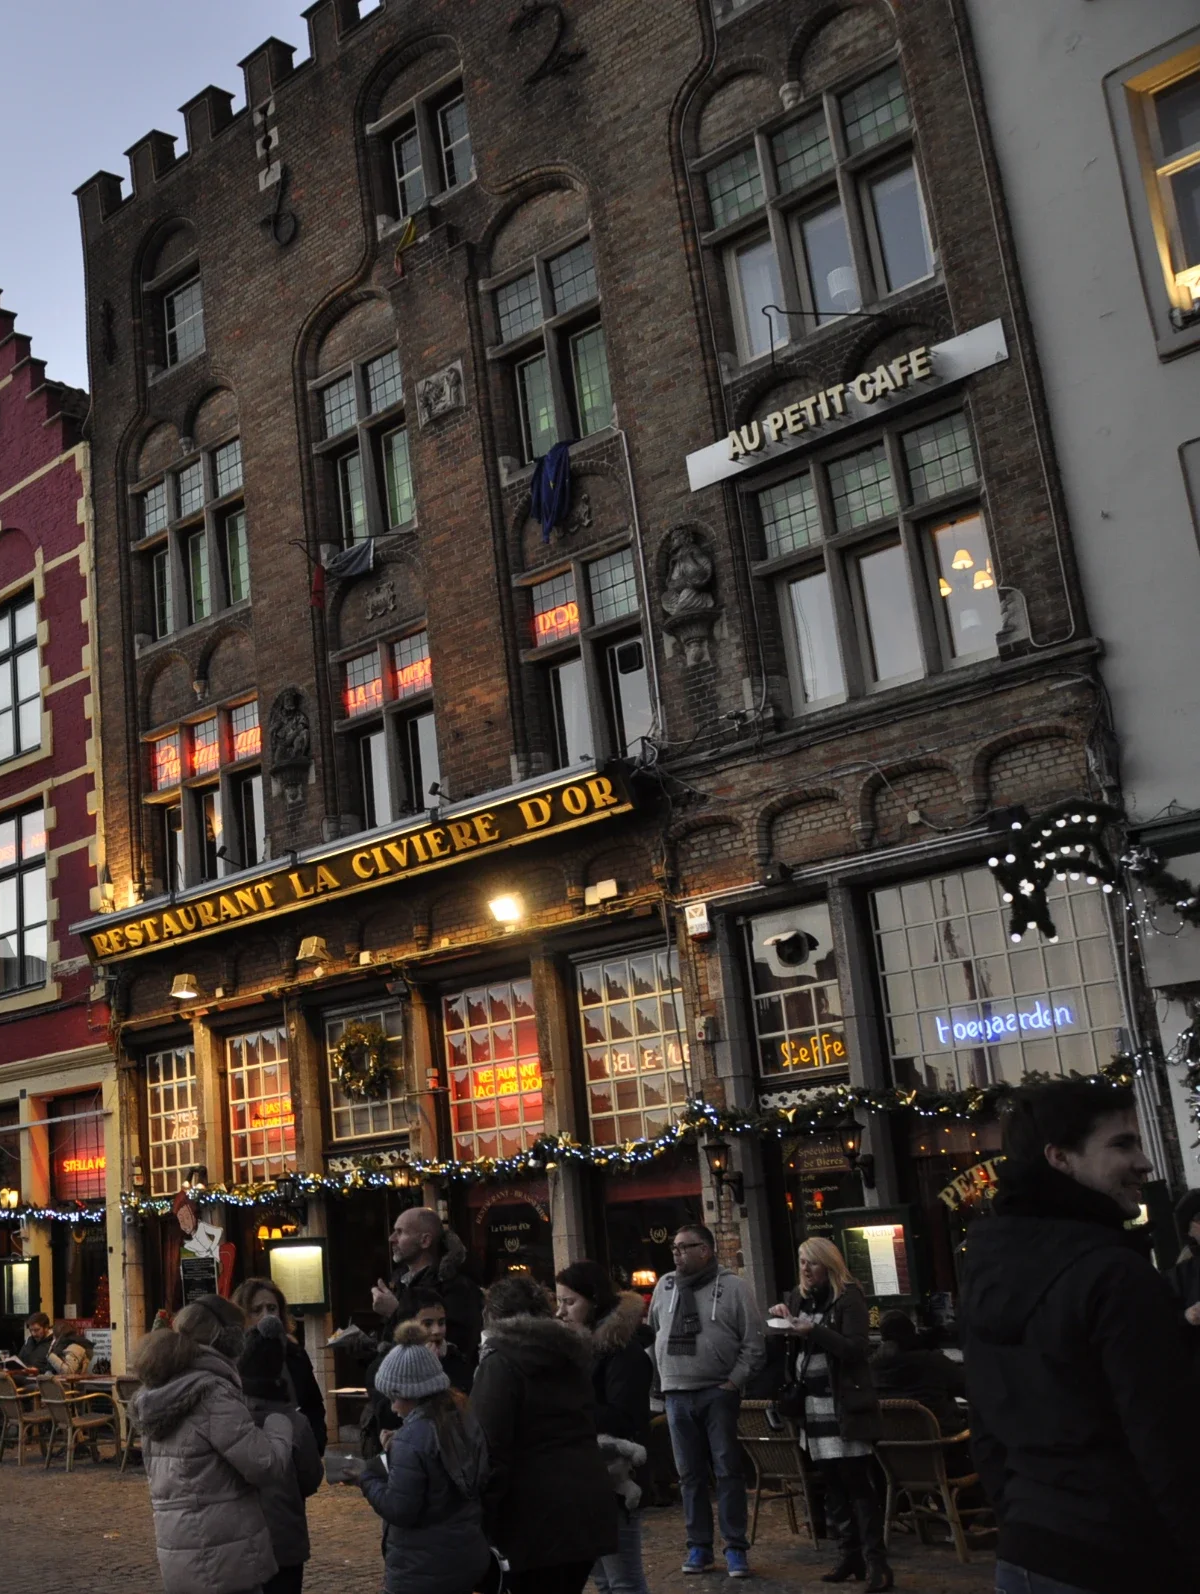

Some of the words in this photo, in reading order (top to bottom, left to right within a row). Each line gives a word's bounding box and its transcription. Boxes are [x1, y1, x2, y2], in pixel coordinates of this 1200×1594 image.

[728, 420, 764, 461] AU
[766, 383, 850, 443] PETIT
[853, 345, 933, 404] CAFE
[90, 880, 277, 957] RESTAURANT
[288, 864, 341, 899] LA
[351, 812, 501, 879] CIVIERE
[517, 776, 619, 830] D'OR
[604, 1042, 692, 1075] BELE-VUE
[779, 1033, 846, 1068] Leffe
